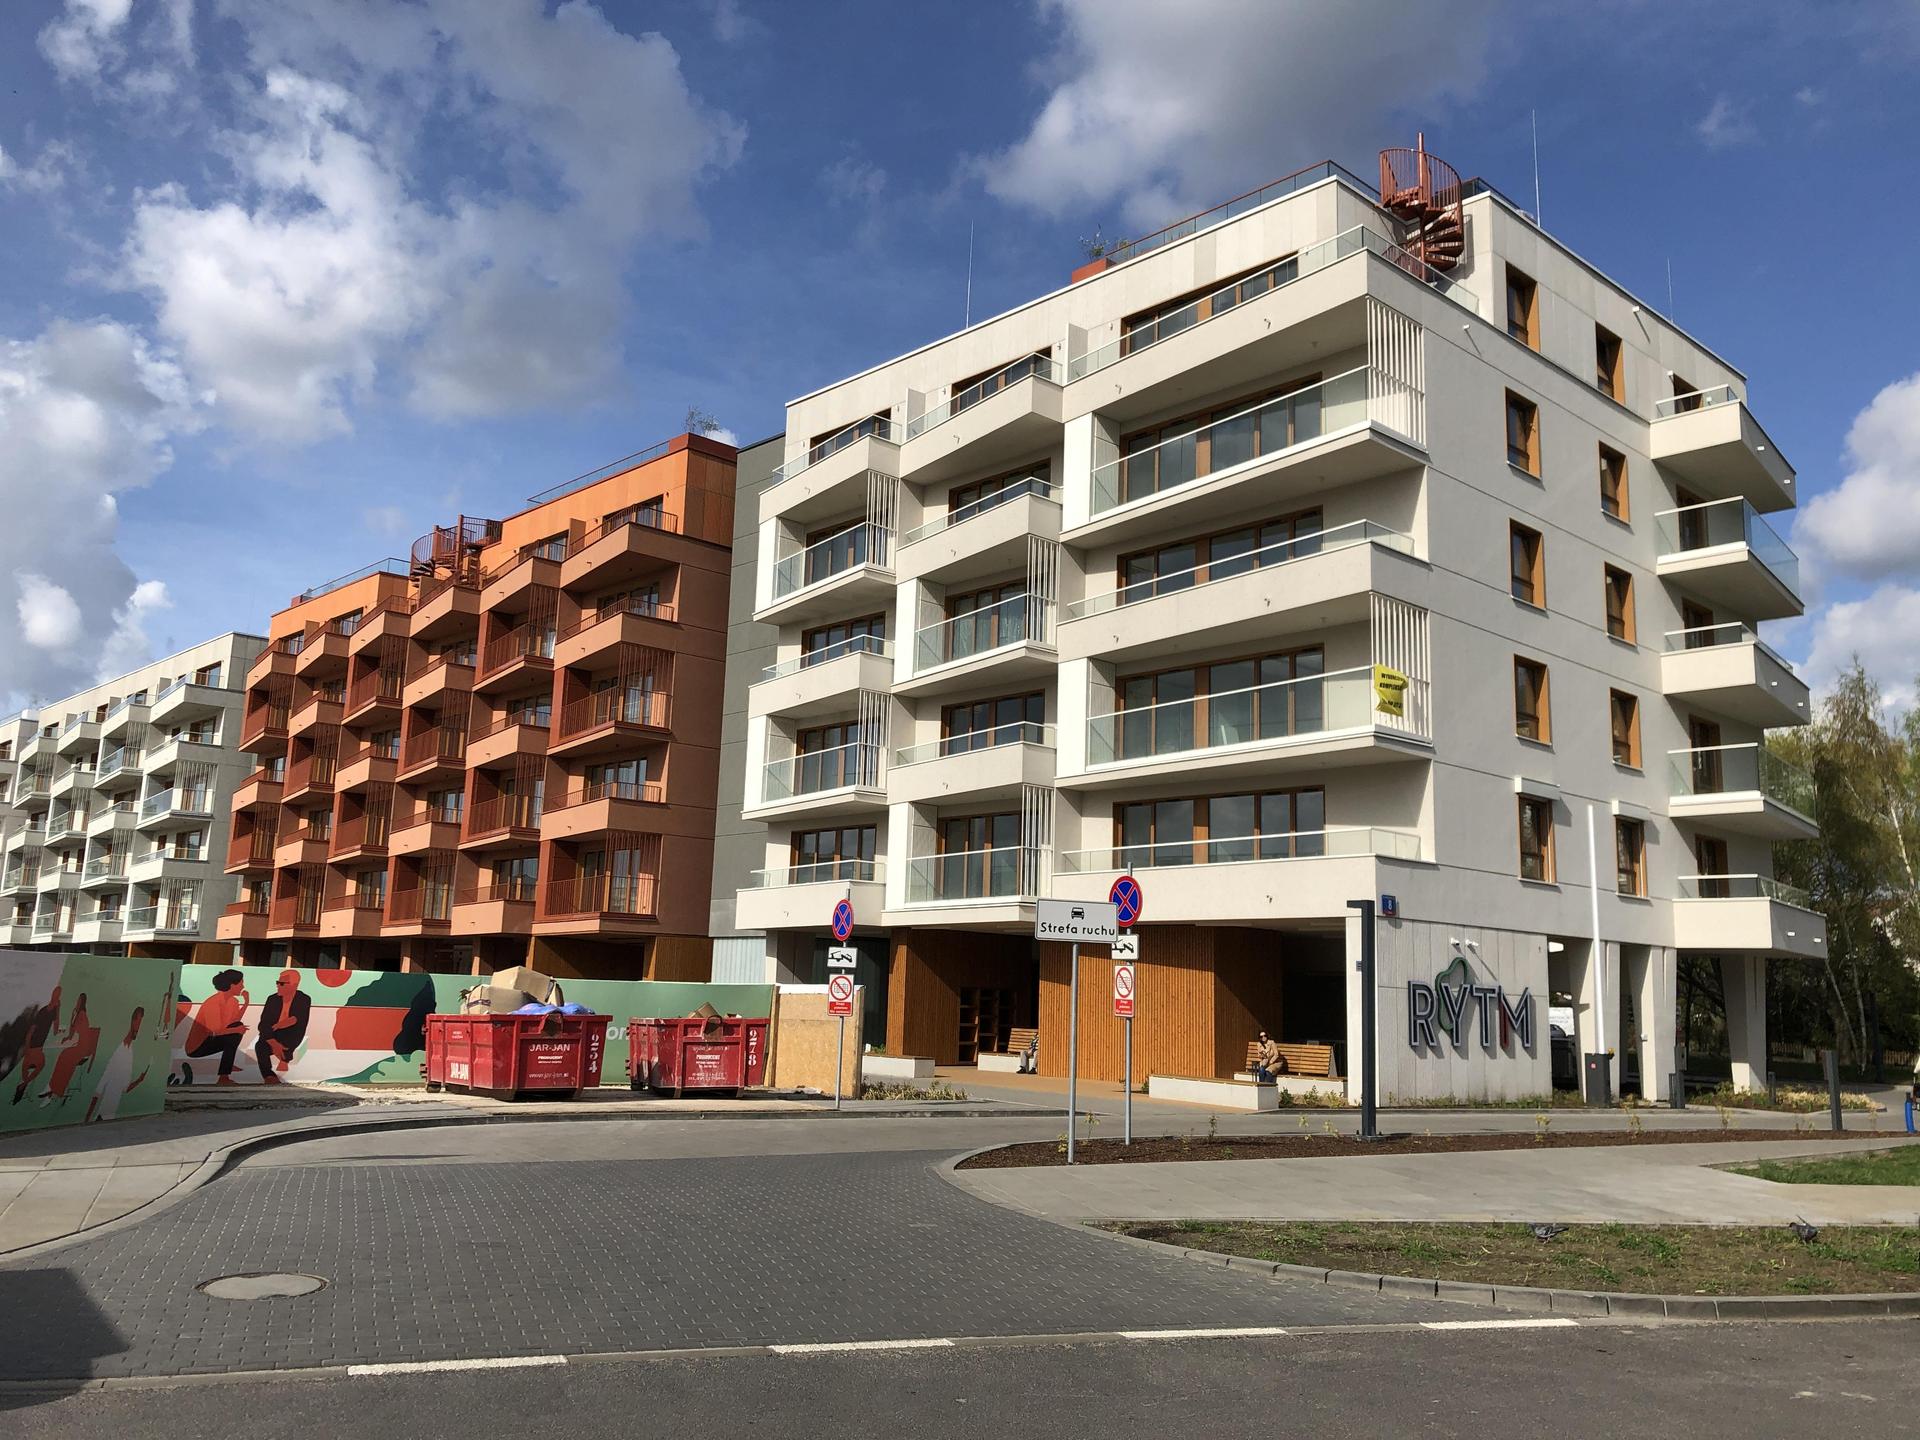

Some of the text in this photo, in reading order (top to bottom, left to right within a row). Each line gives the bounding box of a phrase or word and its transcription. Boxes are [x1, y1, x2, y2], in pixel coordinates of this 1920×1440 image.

[1040, 922, 1115, 936] Strefa ruchu
[1408, 980, 1532, 1048] RYTM
[529, 1043, 571, 1052] JAR-JAN
[748, 1029, 758, 1067] 278
